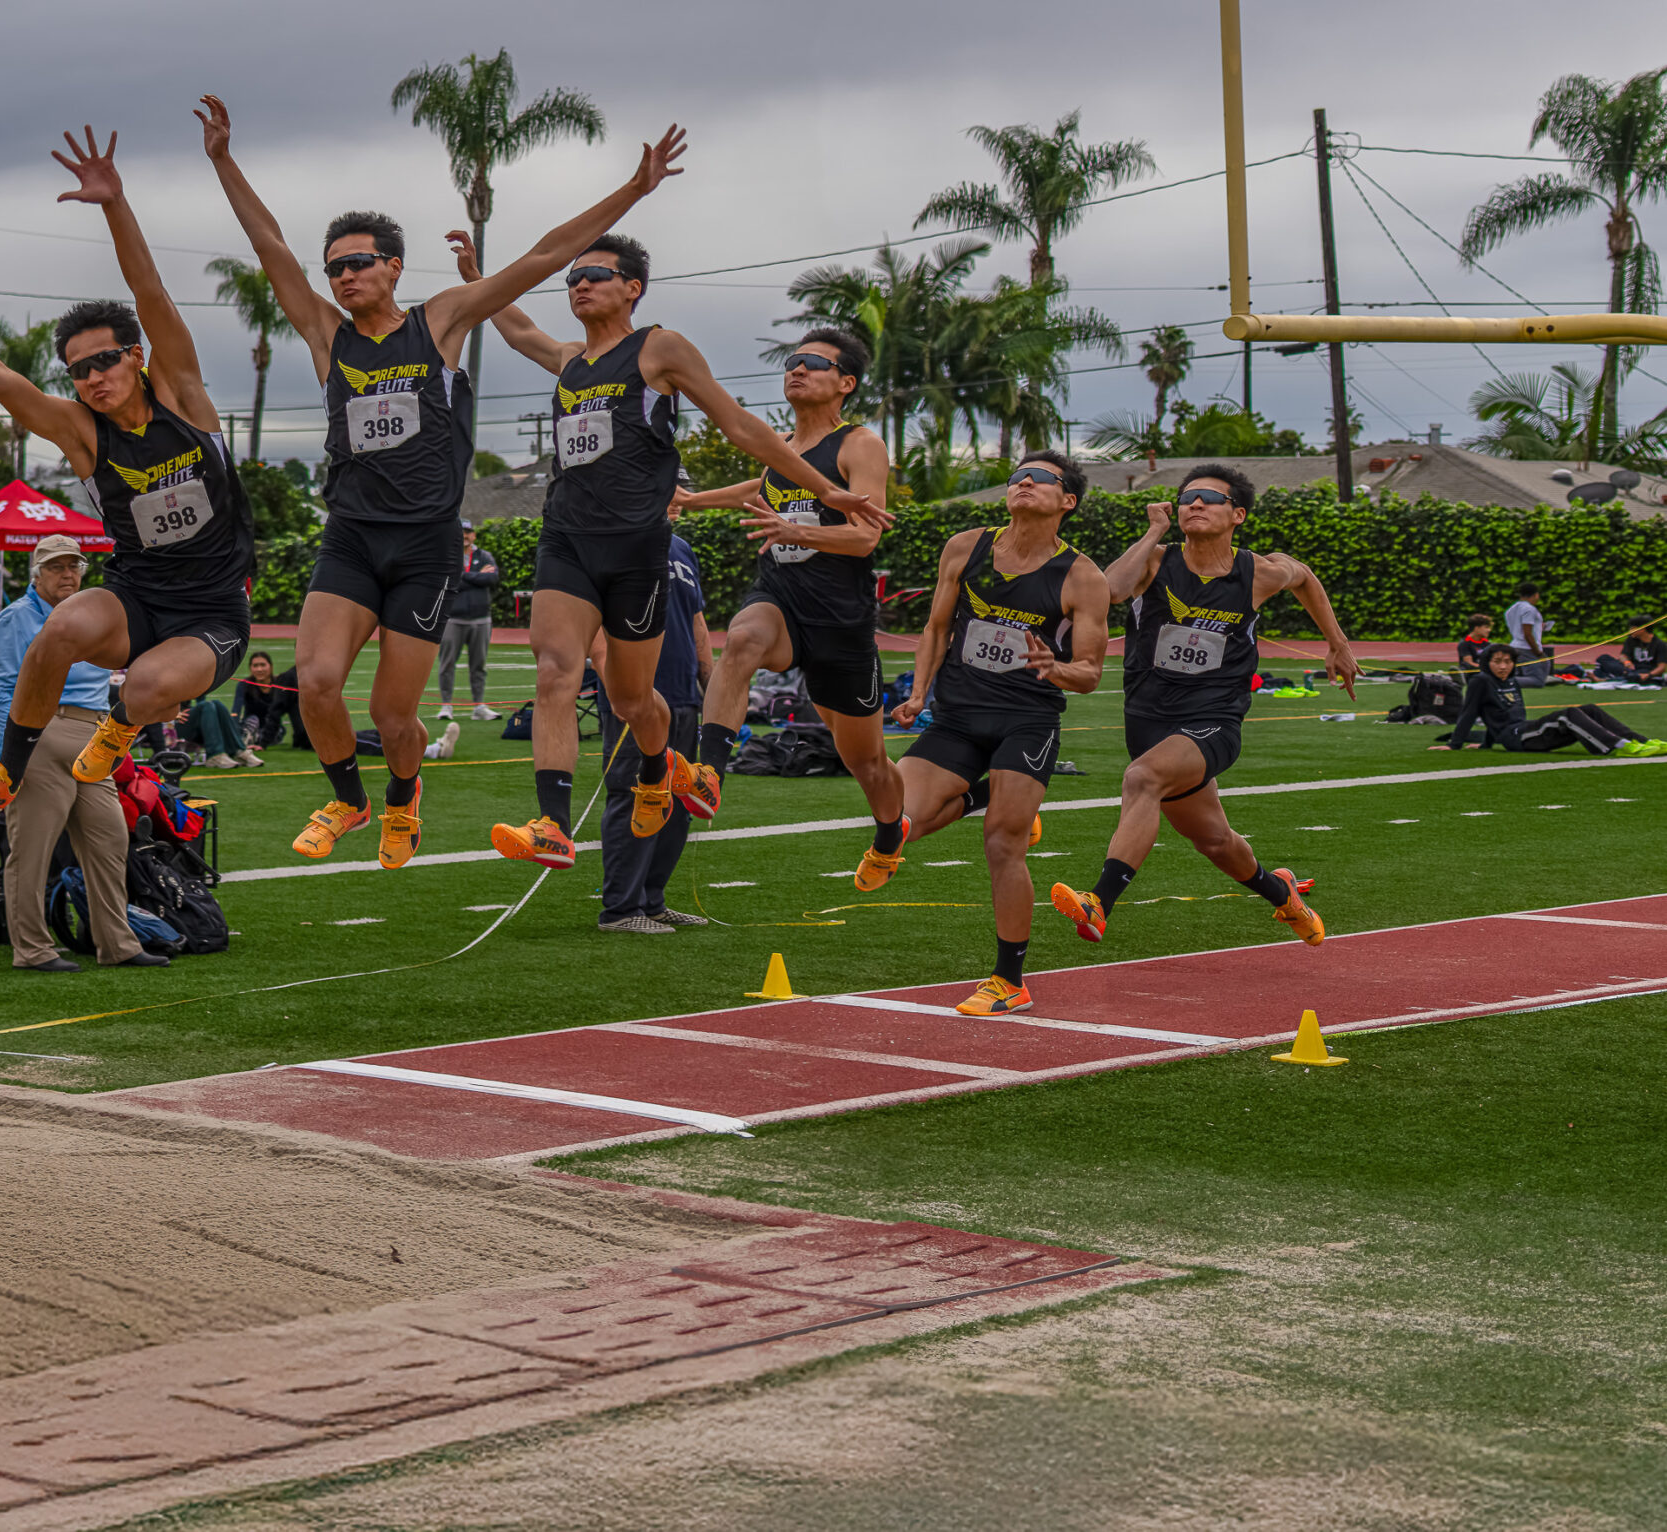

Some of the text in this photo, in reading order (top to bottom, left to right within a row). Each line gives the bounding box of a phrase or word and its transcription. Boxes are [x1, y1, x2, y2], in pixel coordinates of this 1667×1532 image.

[367, 363, 429, 385] PREMIER
[376, 377, 415, 394] ELITE
[575, 383, 627, 405] PREMIER
[579, 396, 610, 413] ELITE
[364, 416, 404, 439] 398
[566, 433, 599, 456] 398
[145, 446, 203, 483] PREMIER
[158, 464, 194, 490] ELITE
[787, 499, 814, 512] ELITE
[153, 506, 198, 534] 398
[5, 534, 38, 545] MATER
[989, 604, 1046, 626] PREMIER
[995, 617, 1031, 631] ELITE
[1189, 606, 1244, 624] PREMIER
[1191, 617, 1230, 632] ELITE
[975, 641, 1015, 665] 398
[1169, 645, 1208, 666] 398
[100, 738, 121, 752] PUMA
[316, 814, 333, 826] PUMA
